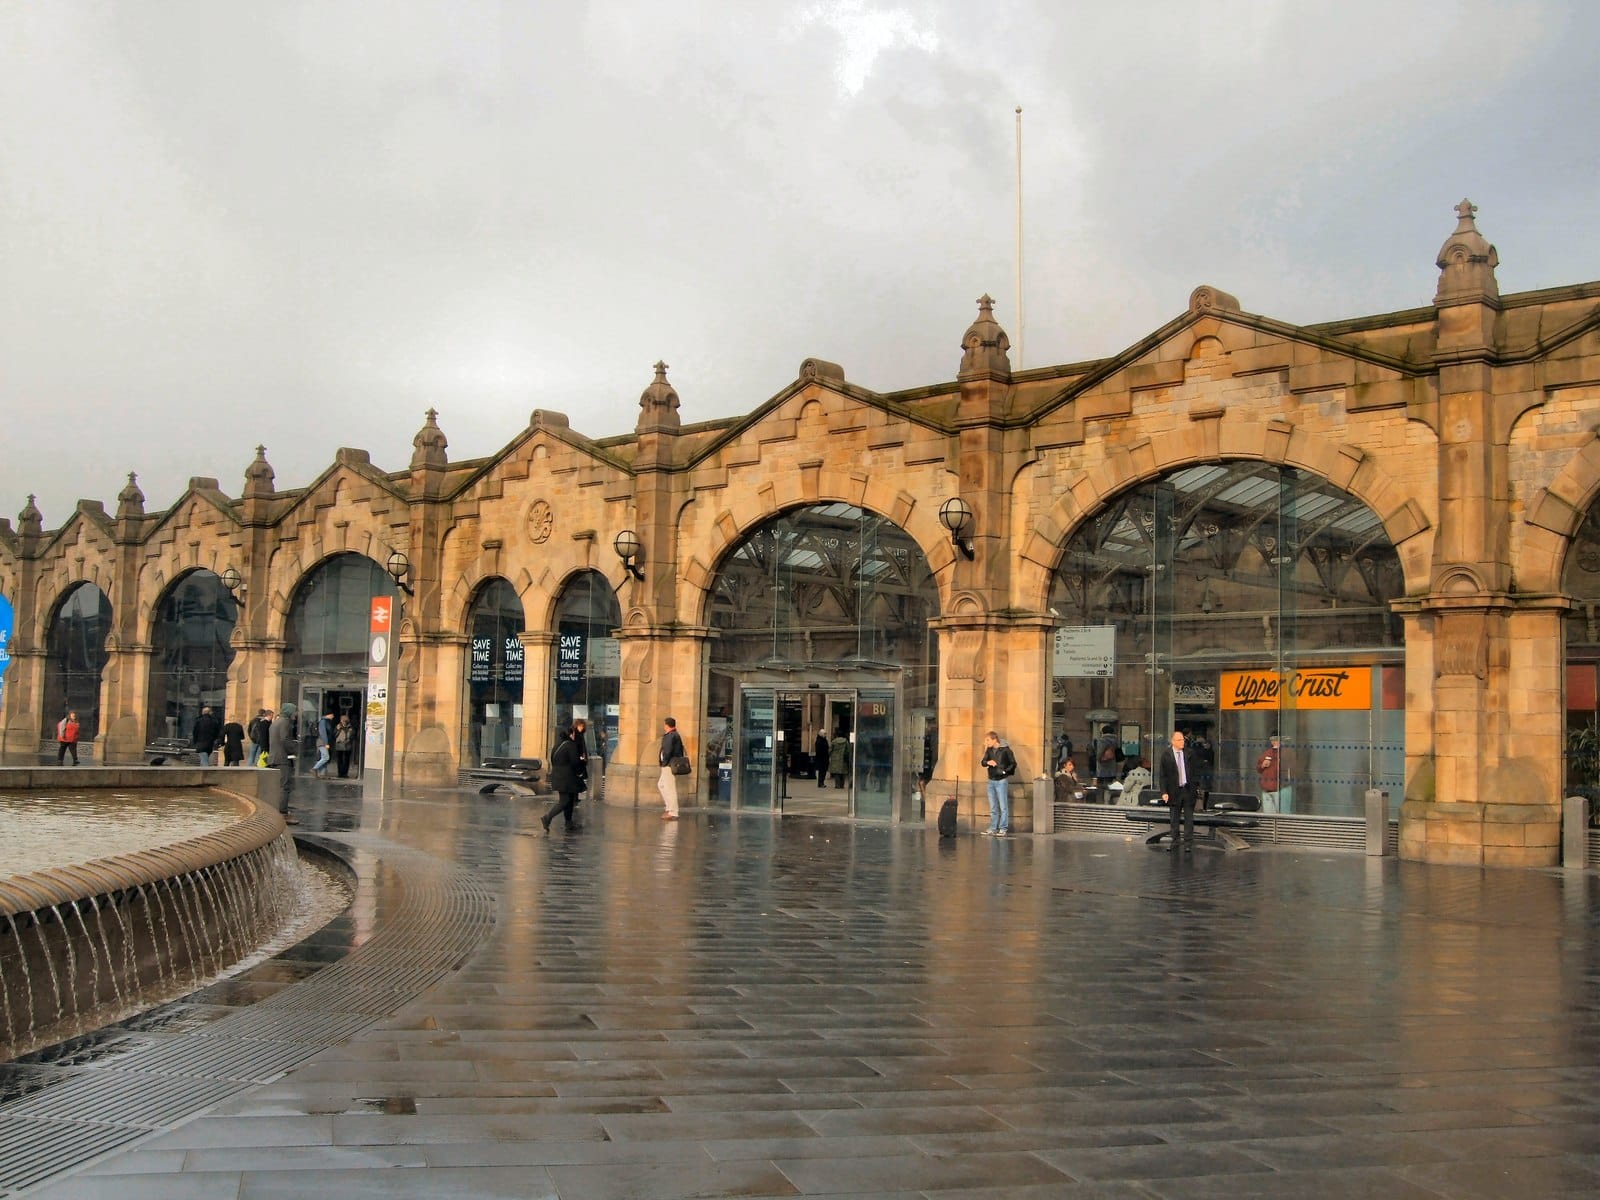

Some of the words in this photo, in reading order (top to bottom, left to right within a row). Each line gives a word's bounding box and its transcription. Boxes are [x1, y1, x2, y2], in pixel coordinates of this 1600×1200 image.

[473, 639, 490, 650] SAVE
[561, 636, 581, 647] SAVE
[473, 651, 489, 661] TIME
[505, 651, 523, 661] TIME
[561, 649, 580, 660] TIME
[1233, 675, 1286, 706] Upper
[1287, 671, 1349, 697] Crust
